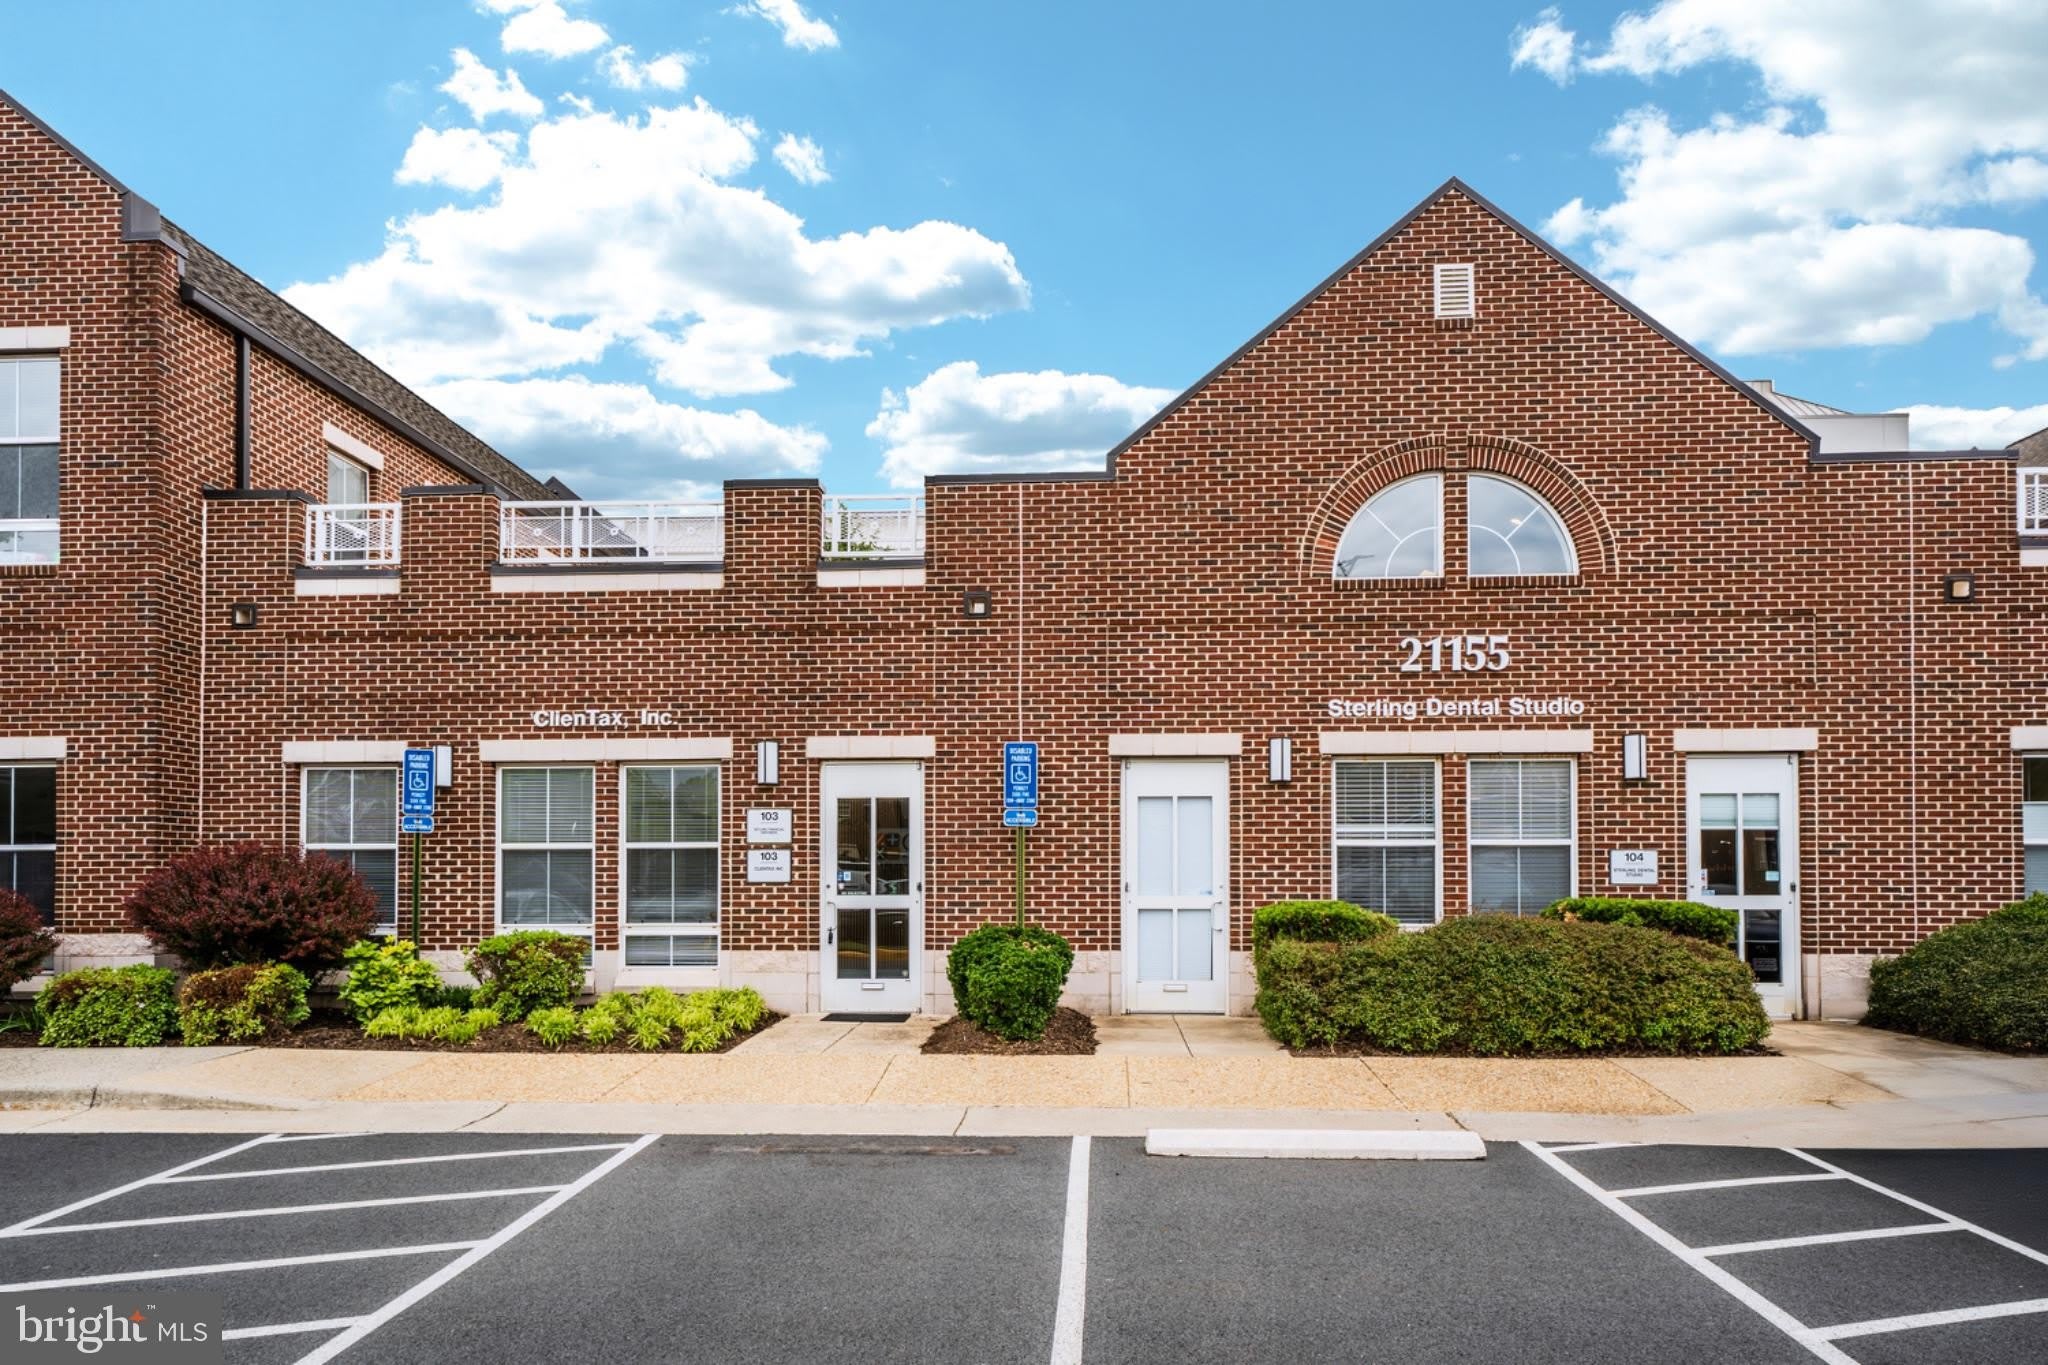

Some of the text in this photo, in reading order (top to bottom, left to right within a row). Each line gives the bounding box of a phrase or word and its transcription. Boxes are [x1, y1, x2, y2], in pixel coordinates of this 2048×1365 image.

[1399, 635, 1510, 673] 21155
[1328, 697, 1585, 720] Sterling Dental Studio
[532, 708, 679, 729] ClienTax, Inc.
[760, 811, 779, 821] 103
[760, 852, 778, 861] 103
[1625, 852, 1644, 862] 104
